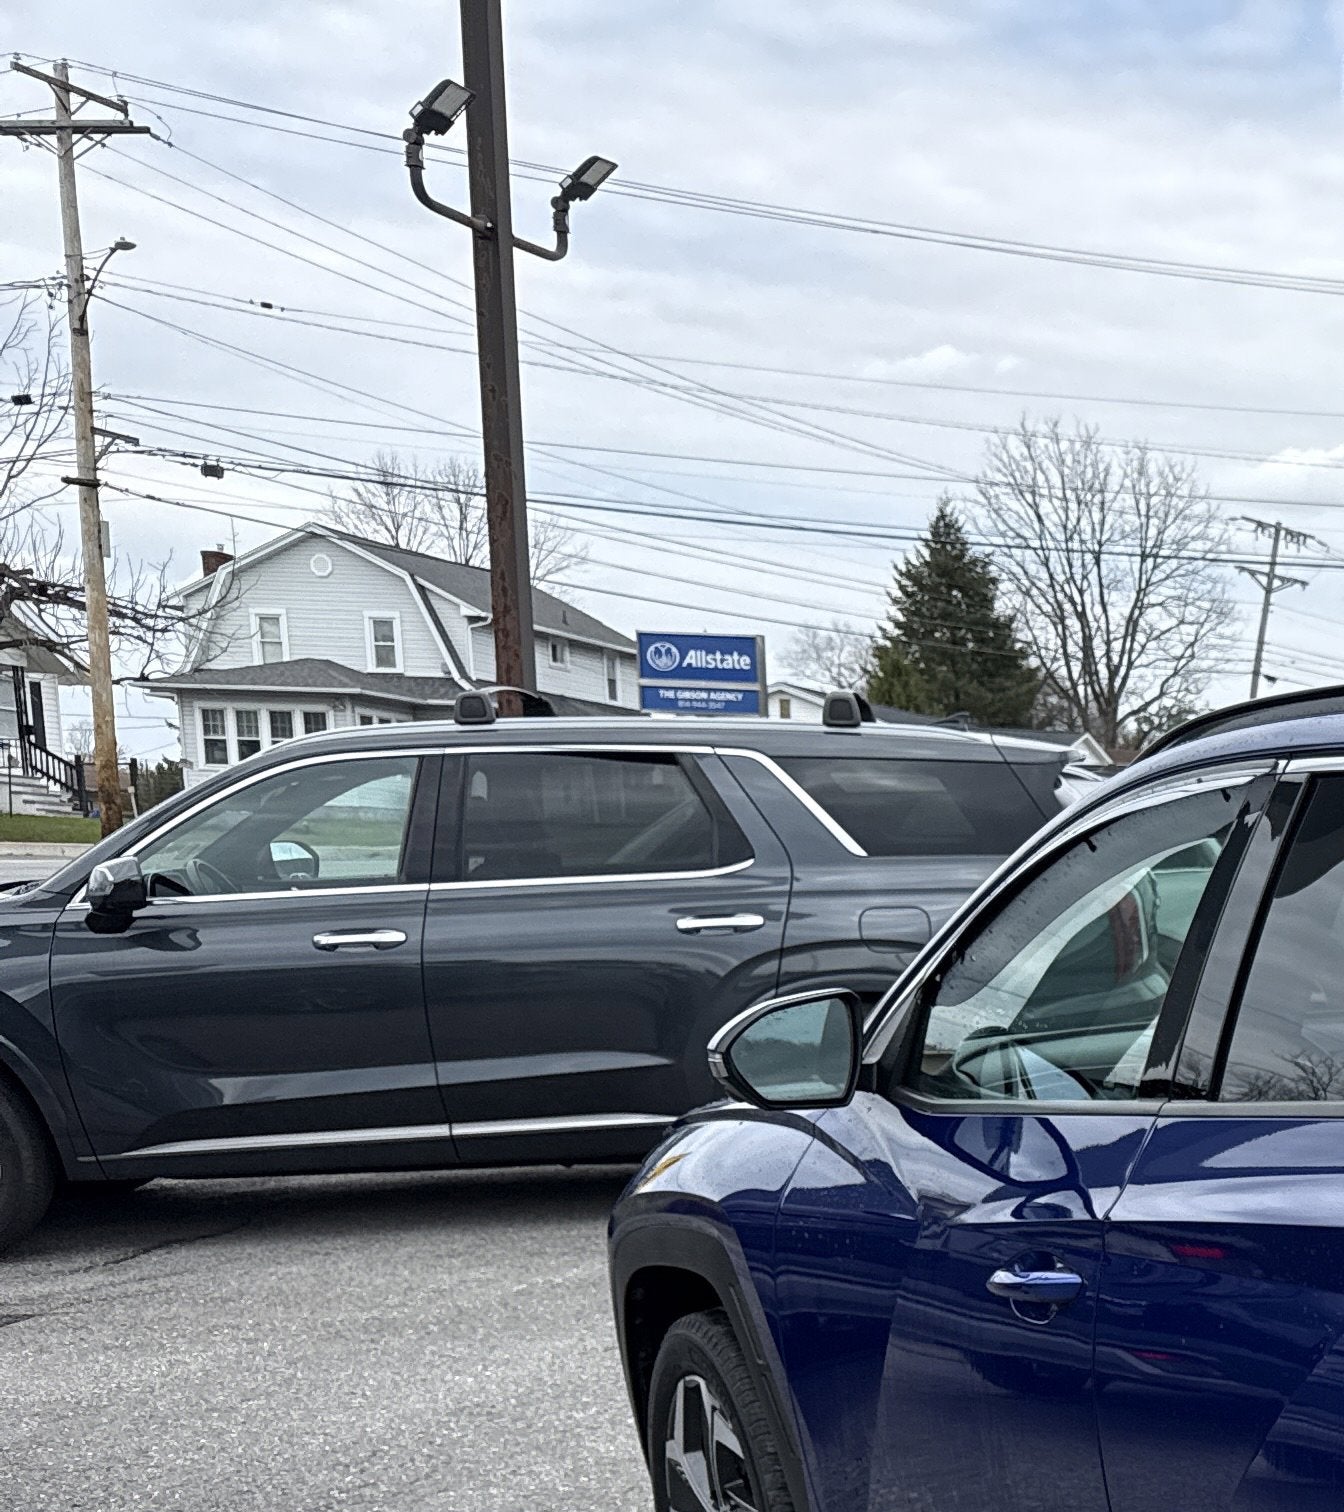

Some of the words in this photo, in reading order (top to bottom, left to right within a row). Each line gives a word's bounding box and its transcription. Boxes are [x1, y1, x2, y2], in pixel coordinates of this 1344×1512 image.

[682, 649, 752, 670] Allstate
[658, 689, 675, 699] THE
[676, 690, 708, 700] GIBSON
[709, 690, 743, 701] AGENCY
